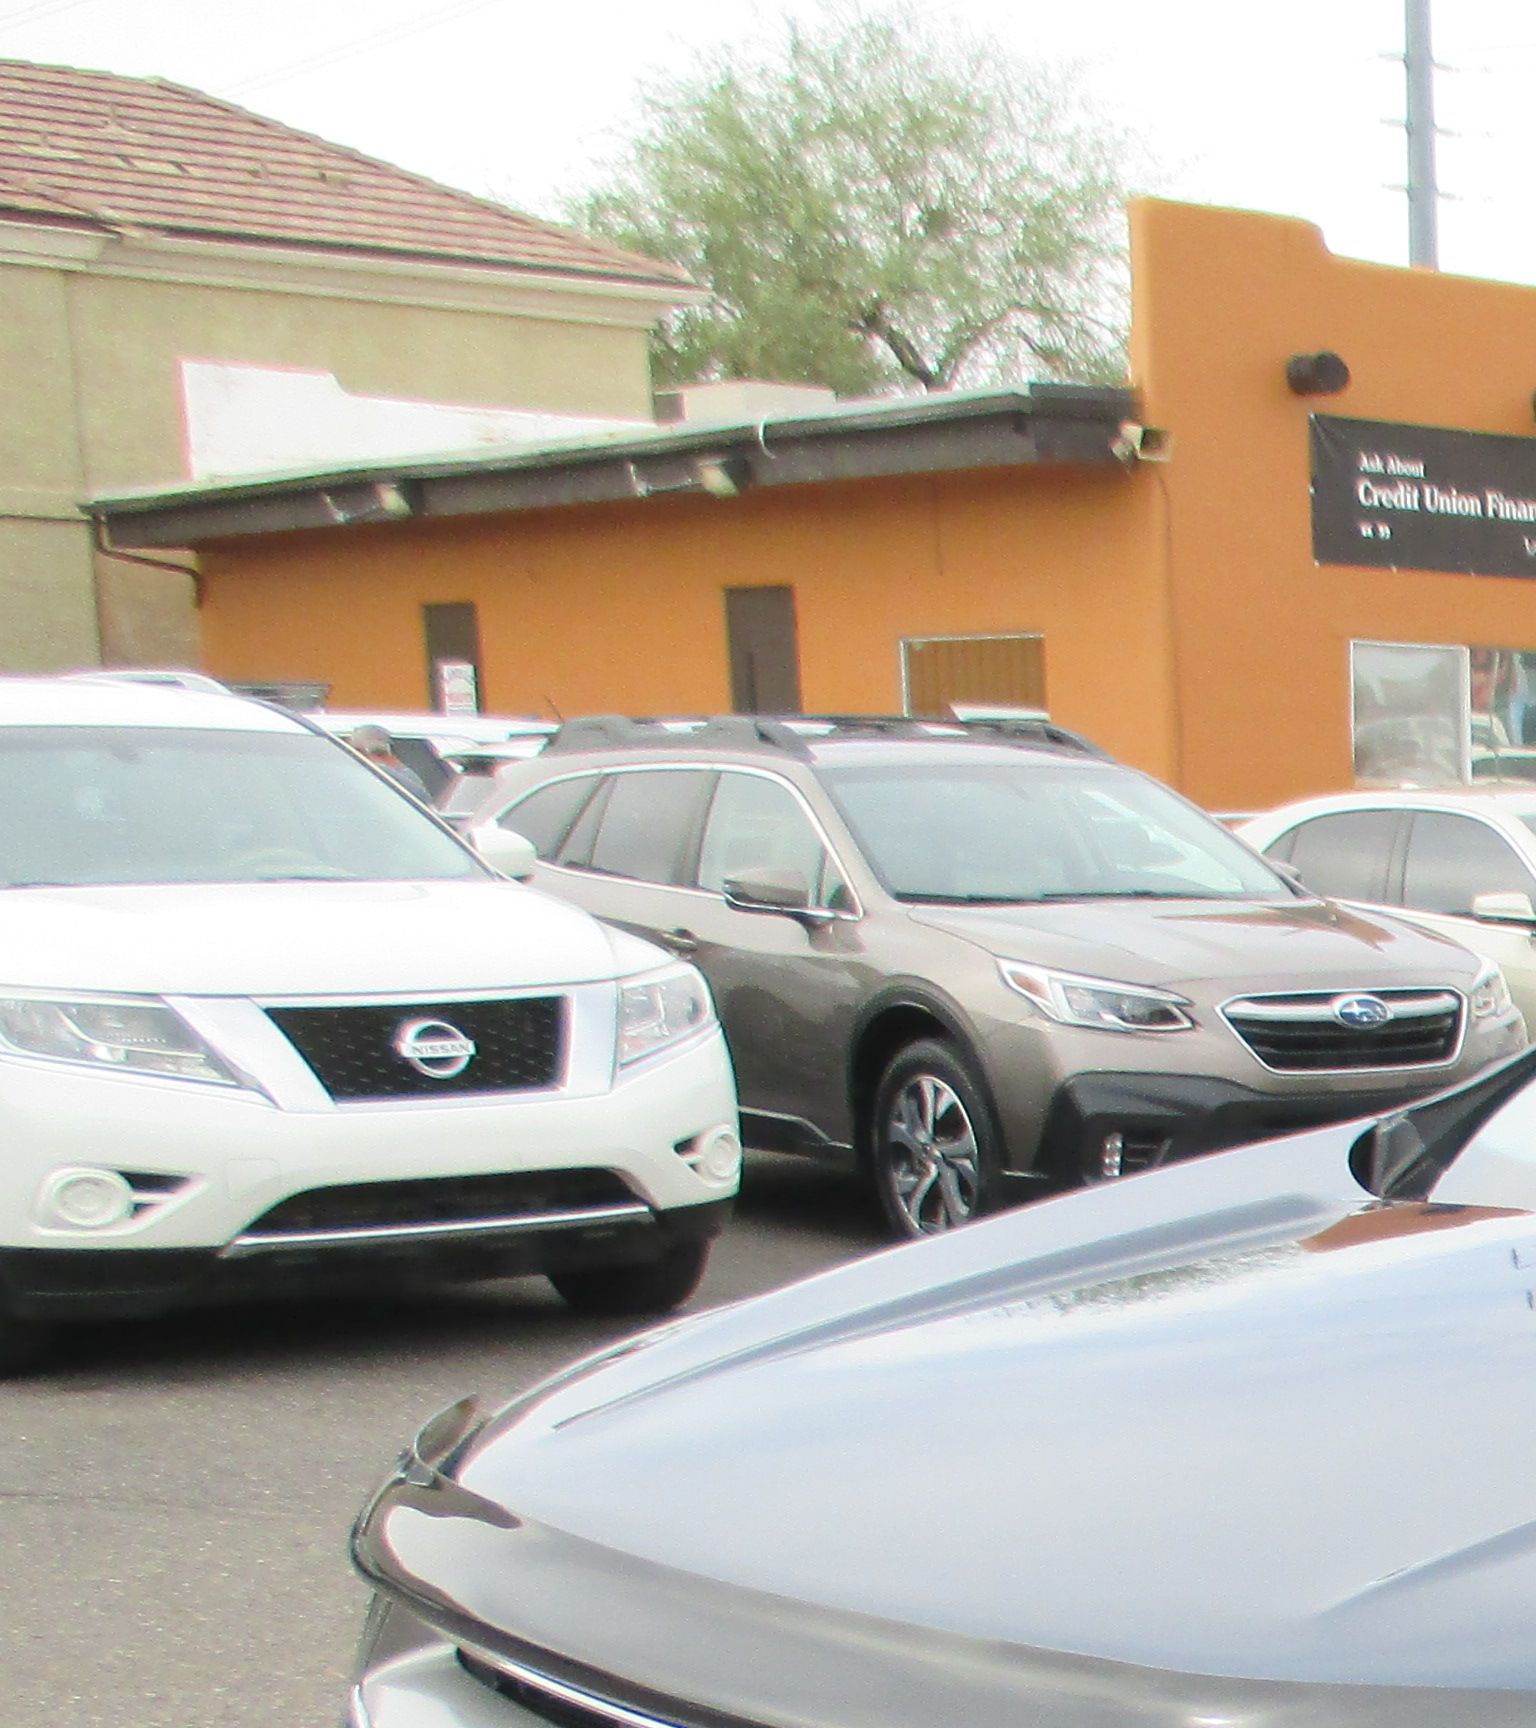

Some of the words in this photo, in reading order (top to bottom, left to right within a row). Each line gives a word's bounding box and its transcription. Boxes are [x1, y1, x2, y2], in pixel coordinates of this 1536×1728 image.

[1358, 452, 1384, 475] Ask
[1387, 455, 1425, 478] About
[1357, 480, 1421, 511] Credit
[1423, 484, 1483, 518] Union
[411, 1042, 470, 1055] NISSAN
